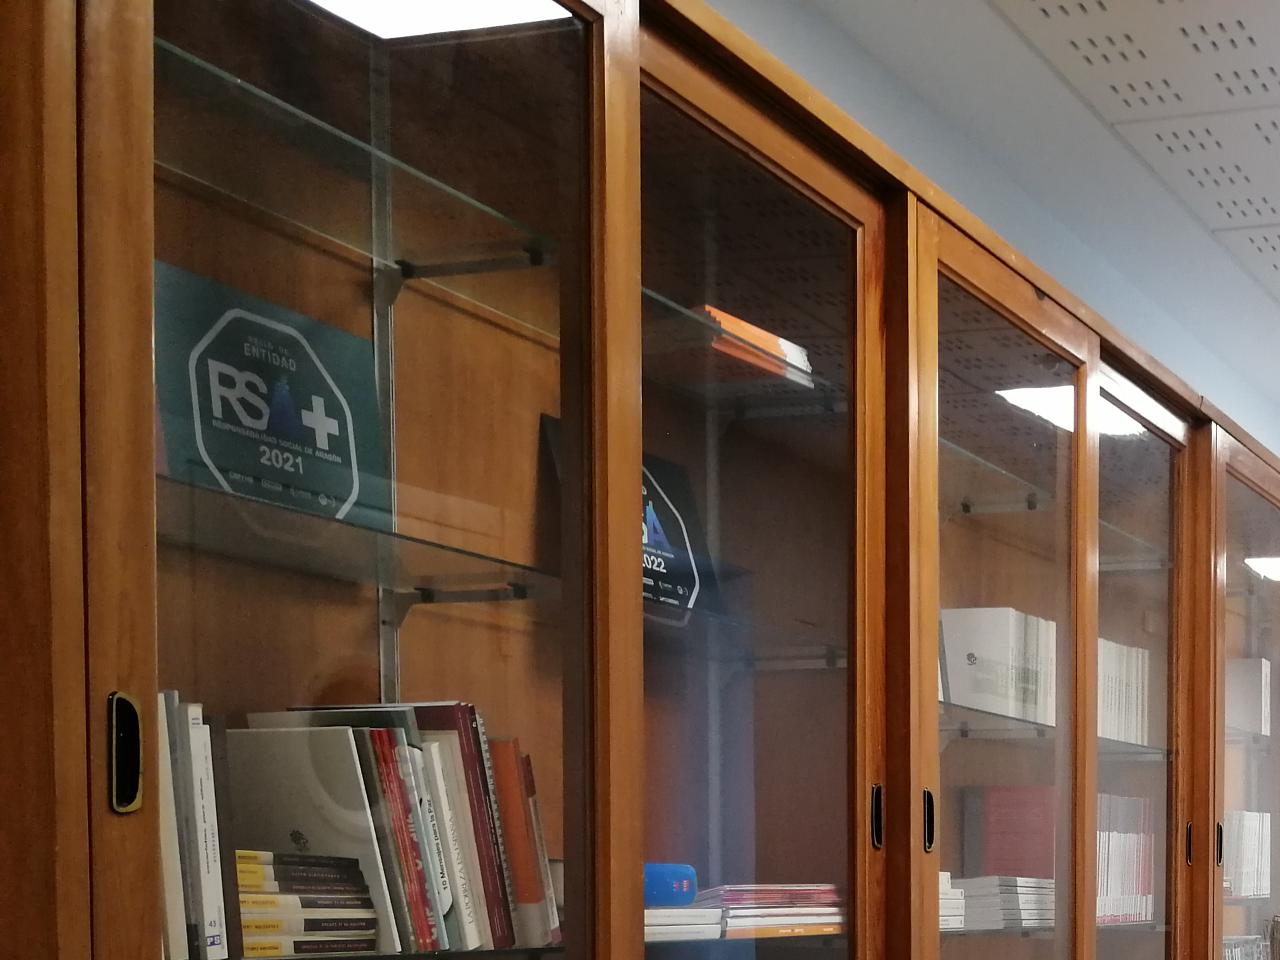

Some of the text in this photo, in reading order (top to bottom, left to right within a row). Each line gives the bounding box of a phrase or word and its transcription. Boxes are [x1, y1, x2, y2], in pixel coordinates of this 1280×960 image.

[243, 343, 296, 372] ENTIDAD
[259, 445, 304, 474] 2021
[431, 823, 440, 841] para
[435, 842, 446, 879] Mensajes
